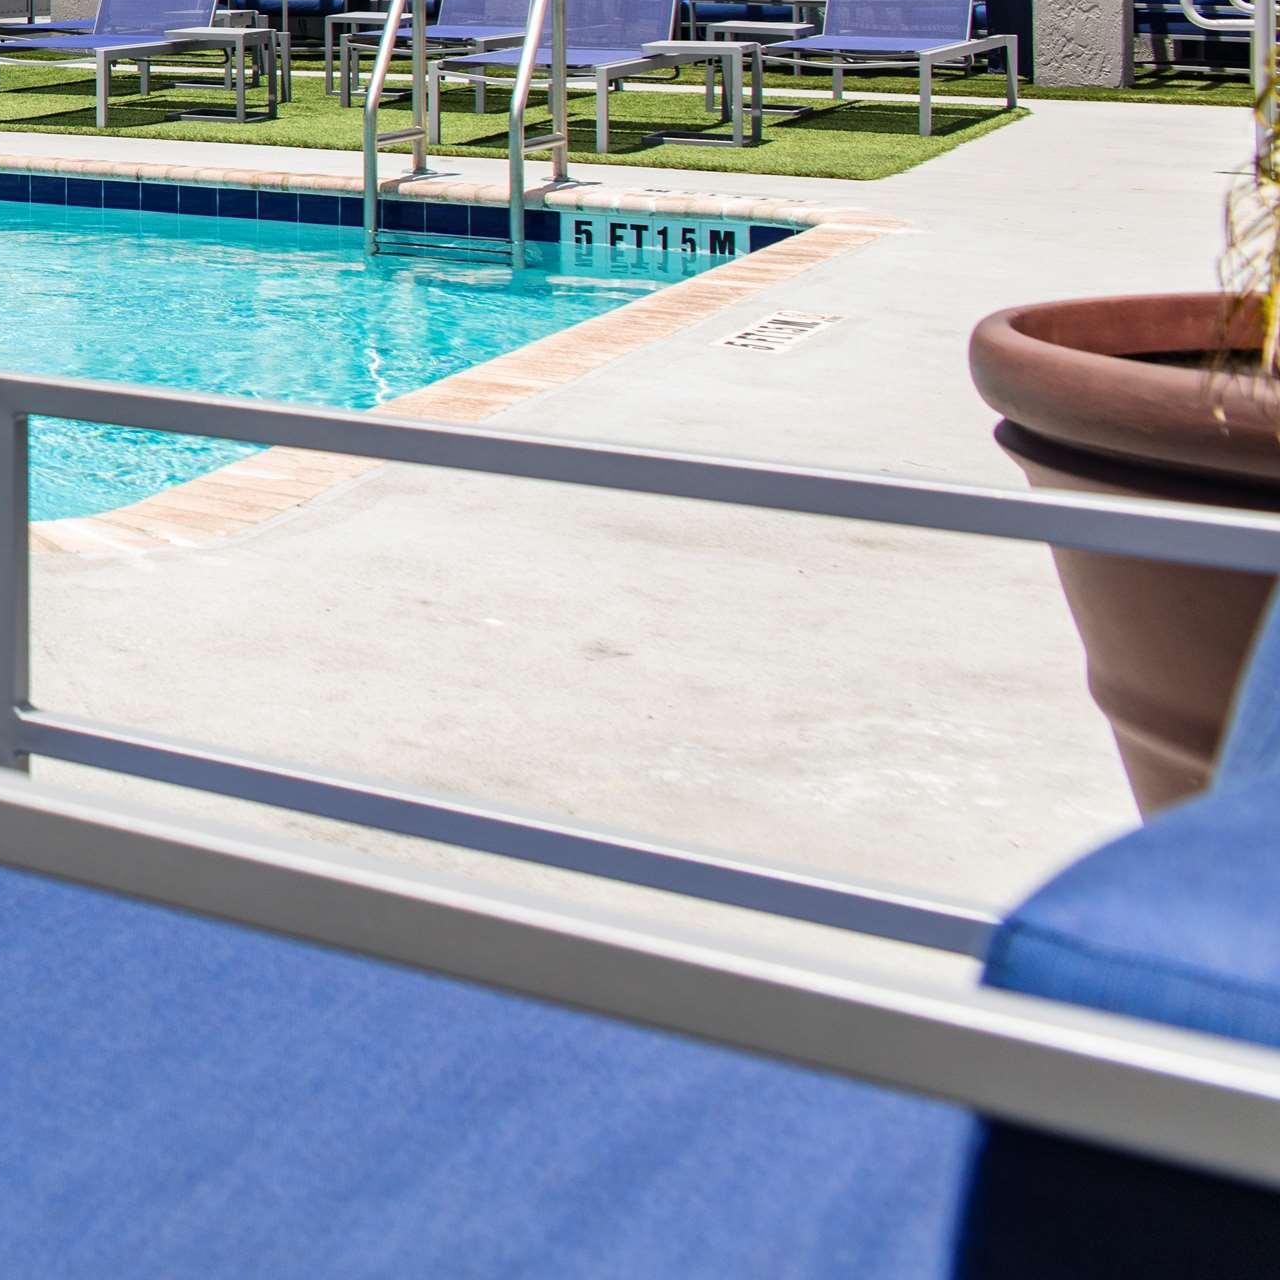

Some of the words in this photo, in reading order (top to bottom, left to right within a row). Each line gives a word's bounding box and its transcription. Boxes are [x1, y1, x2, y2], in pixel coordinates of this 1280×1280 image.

[574, 219, 593, 245] 5
[609, 222, 649, 249] FT
[709, 229, 735, 256] M
